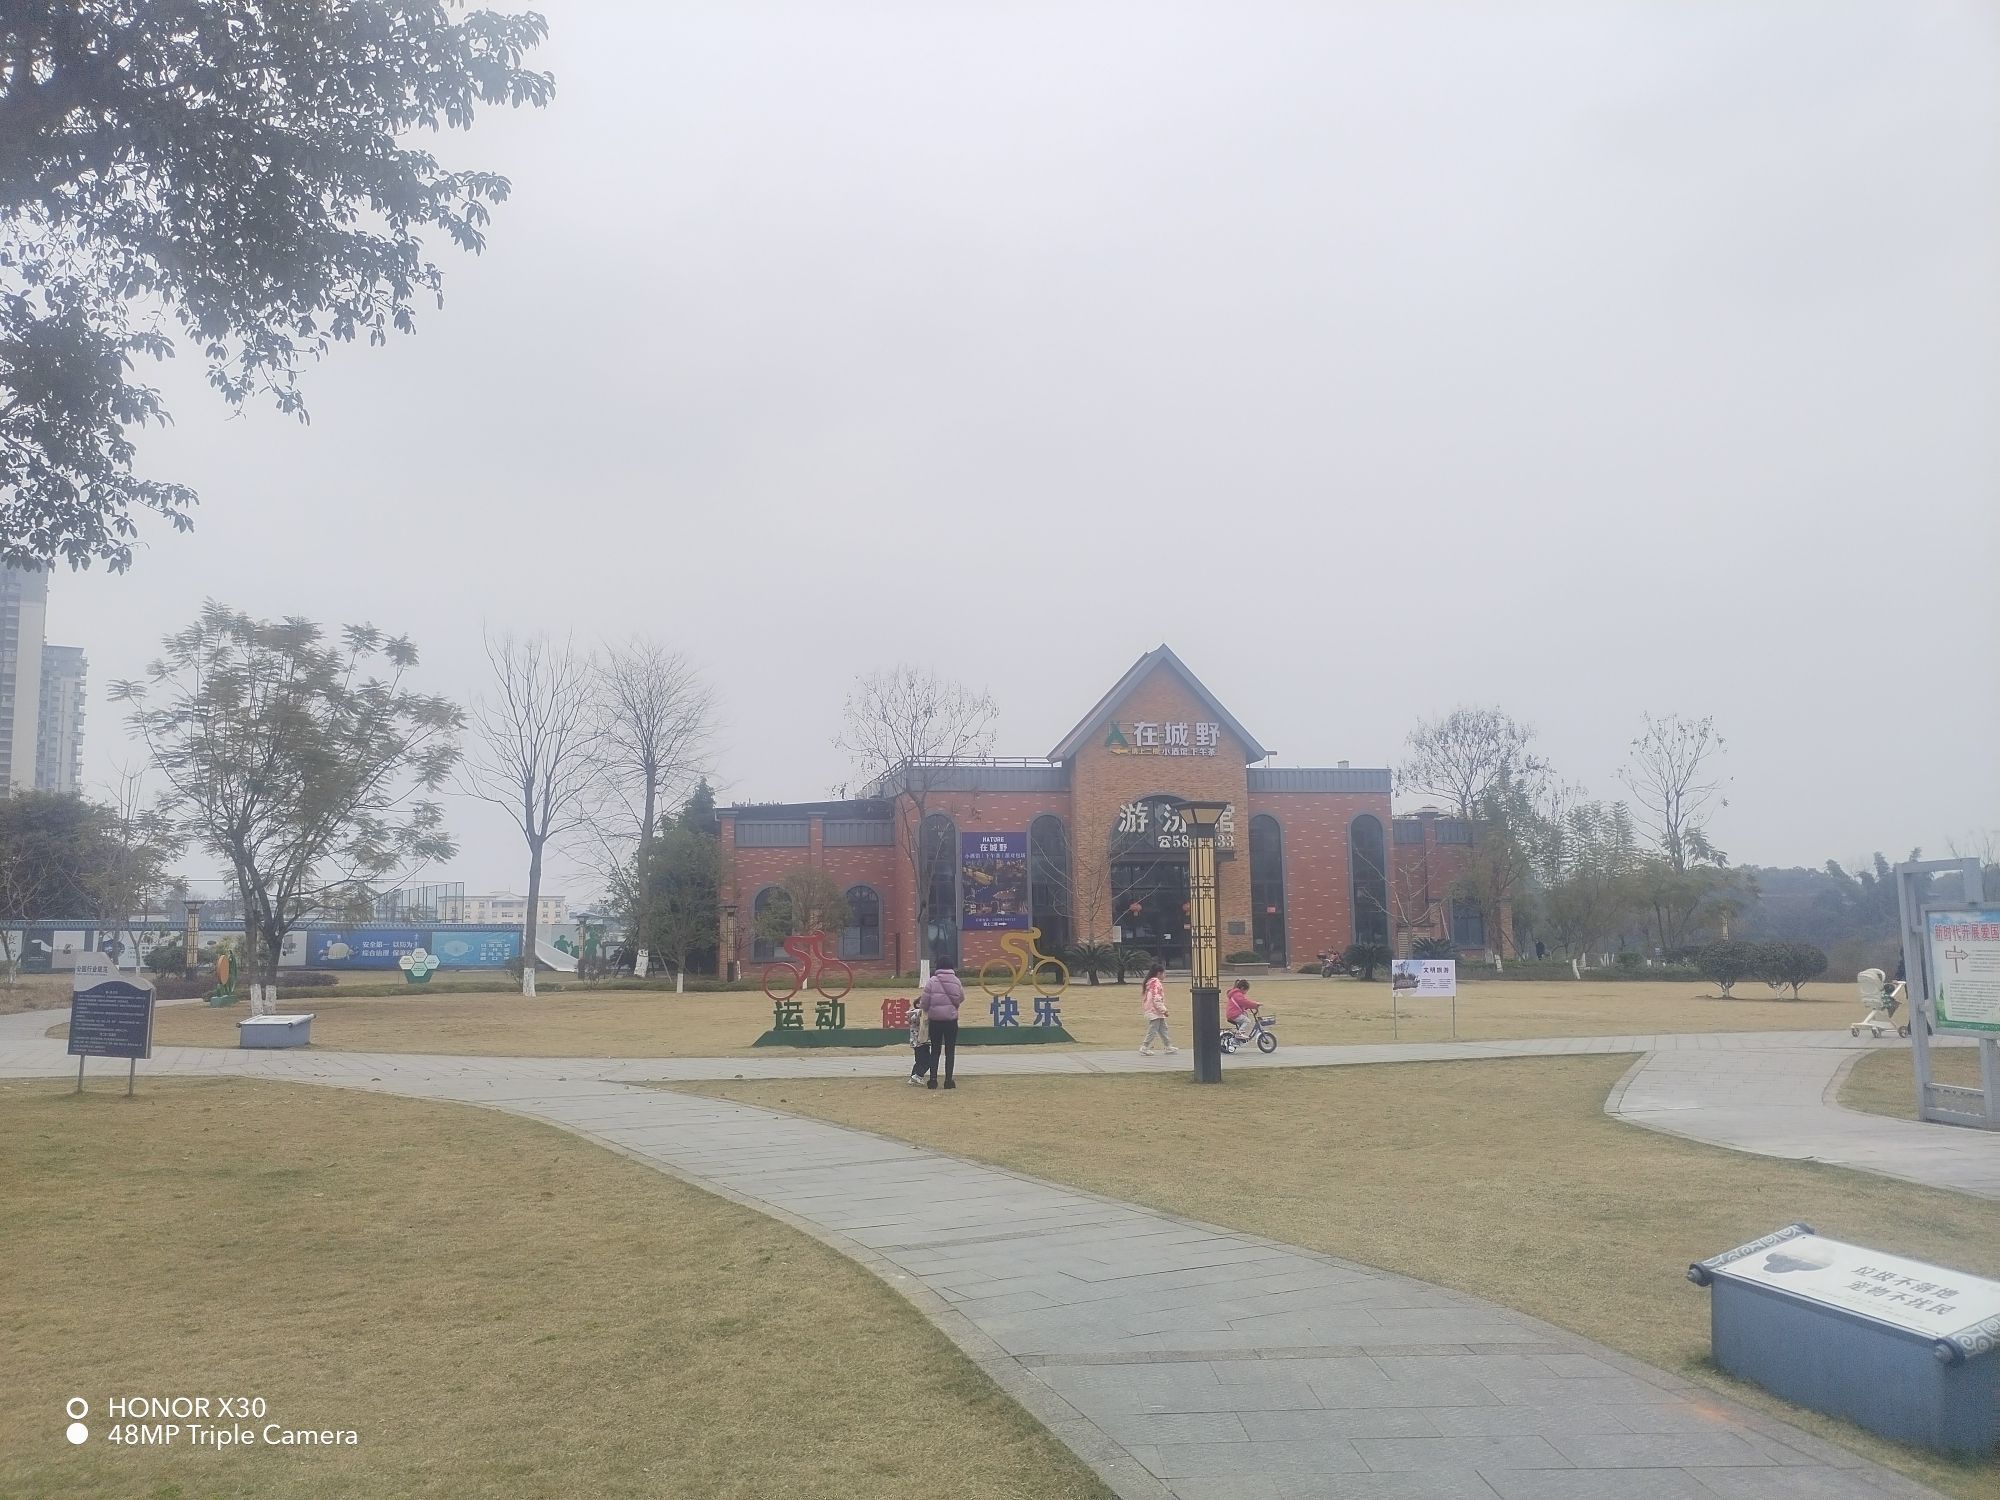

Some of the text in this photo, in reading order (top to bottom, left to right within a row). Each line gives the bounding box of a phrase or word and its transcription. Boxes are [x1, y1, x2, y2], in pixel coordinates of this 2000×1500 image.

[1134, 721, 1221, 747] 在城野
[1190, 748, 1216, 757] 下午茶
[773, 997, 846, 1031] 运动
[989, 994, 1063, 1028] 快乐
[1845, 1281, 1957, 1315] 宠物不扰民
[1851, 1265, 1959, 1299] 垃圾不落地
